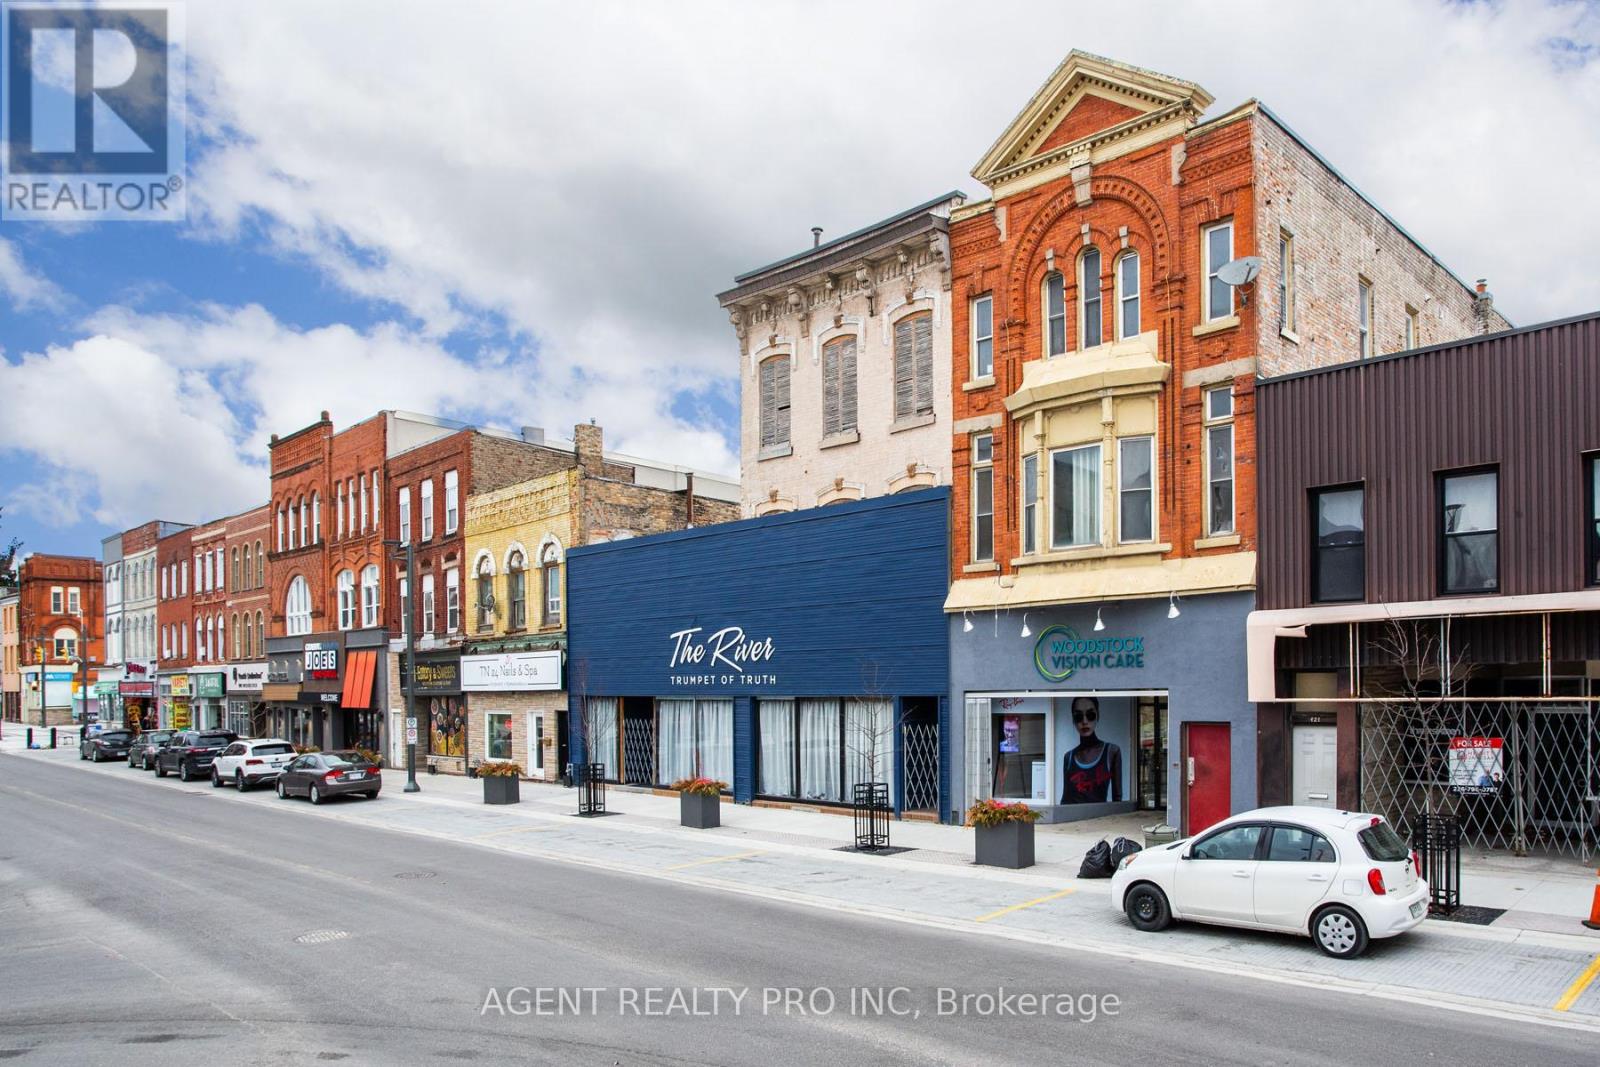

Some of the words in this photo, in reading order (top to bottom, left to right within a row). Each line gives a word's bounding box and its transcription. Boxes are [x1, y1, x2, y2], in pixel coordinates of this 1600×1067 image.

[670, 627, 706, 668] The
[707, 626, 776, 673] River
[1051, 637, 1144, 654] WOODSTOCK
[1052, 655, 1100, 669] VISION
[1104, 653, 1144, 668] CARE
[500, 662, 516, 676] Nails
[518, 664, 522, 676] &
[524, 664, 538, 679] Spa
[670, 675, 716, 685] TRUMPET
[720, 675, 734, 684] OF
[737, 675, 776, 684] TRUTH
[1457, 740, 1472, 748] FOR
[1473, 740, 1492, 748] SALE
